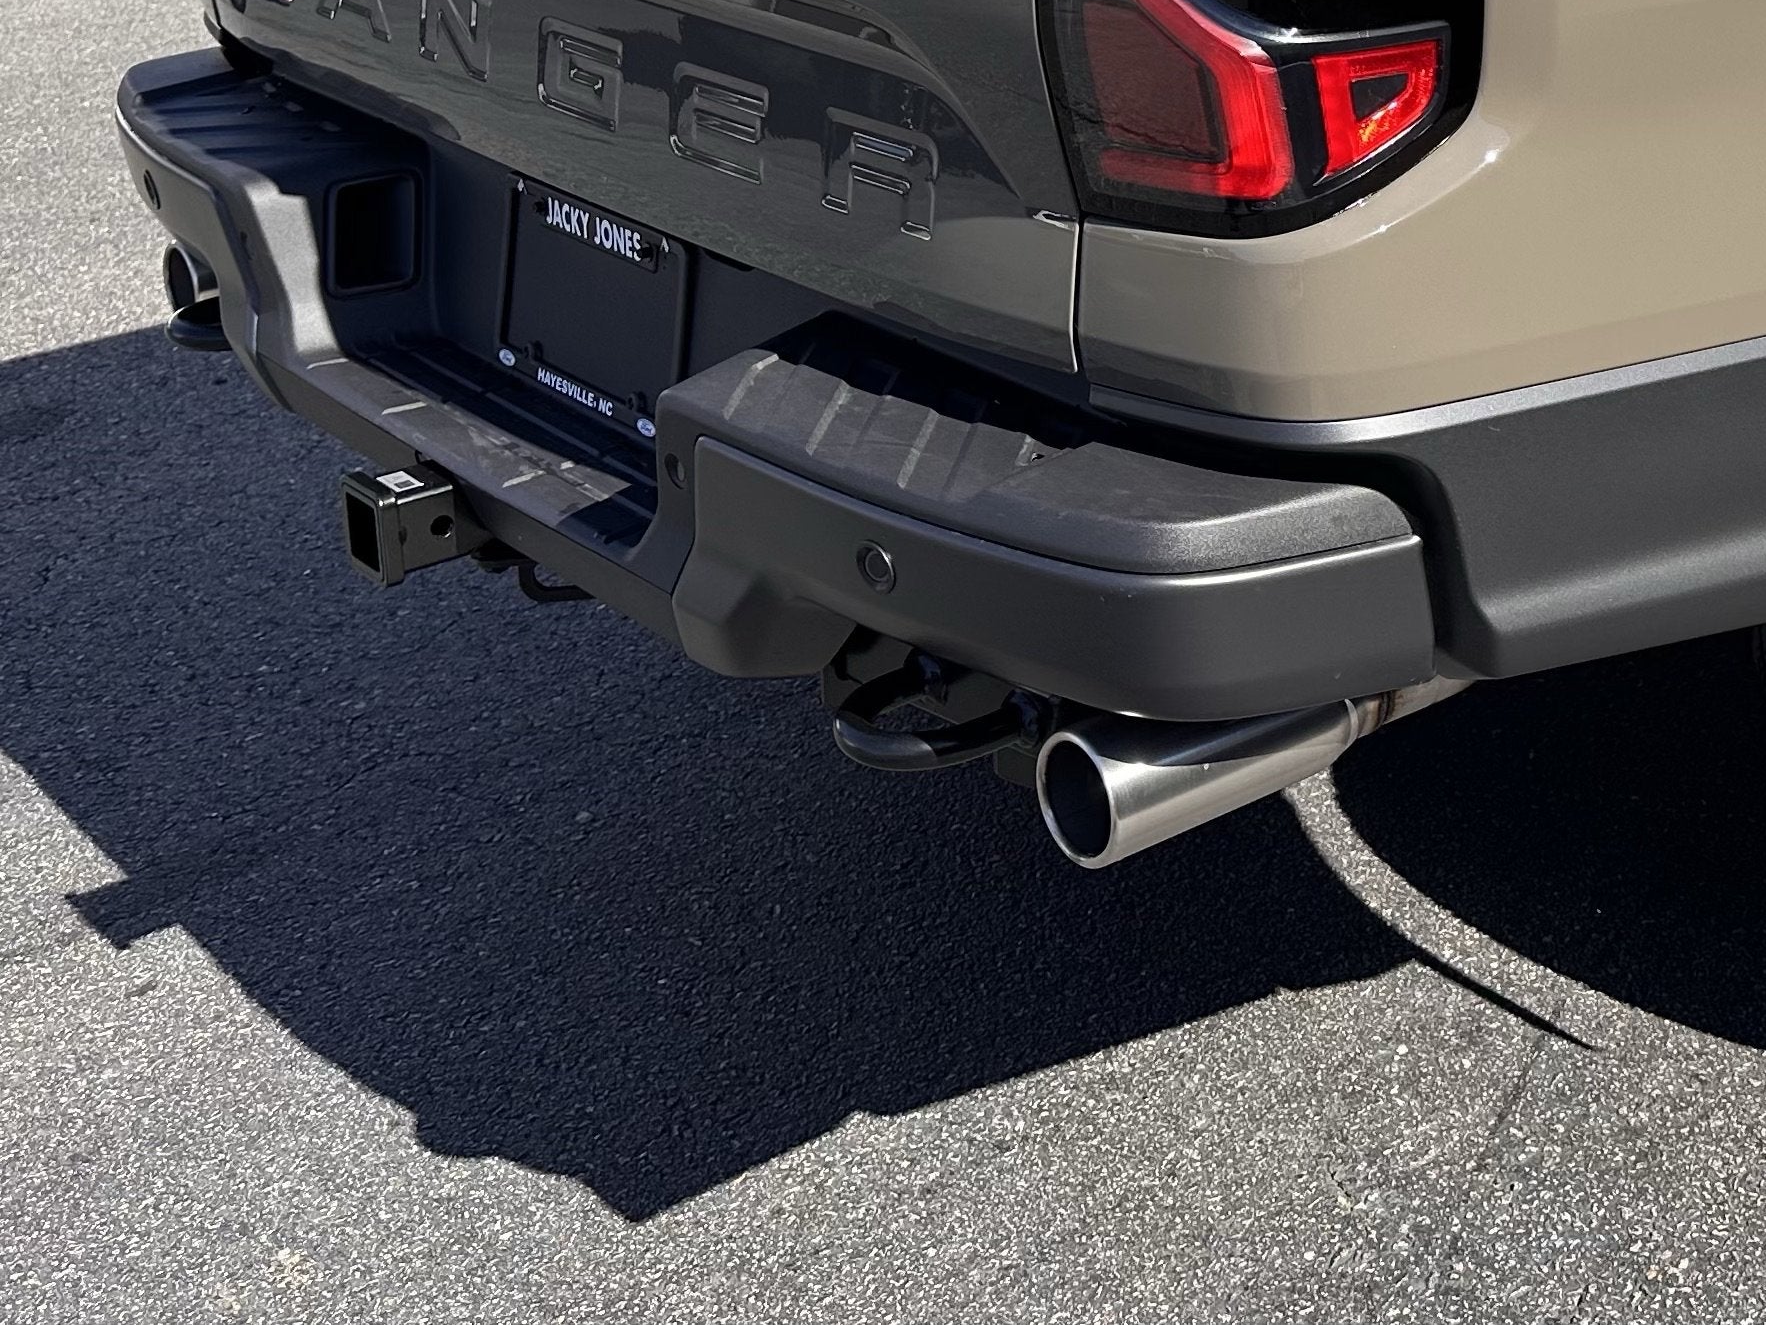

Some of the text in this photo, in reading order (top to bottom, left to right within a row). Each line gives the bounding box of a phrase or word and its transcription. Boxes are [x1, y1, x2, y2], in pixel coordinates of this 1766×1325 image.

[546, 196, 643, 262] JACKY JONES
[537, 367, 613, 417] HAYESVILLE, NC
